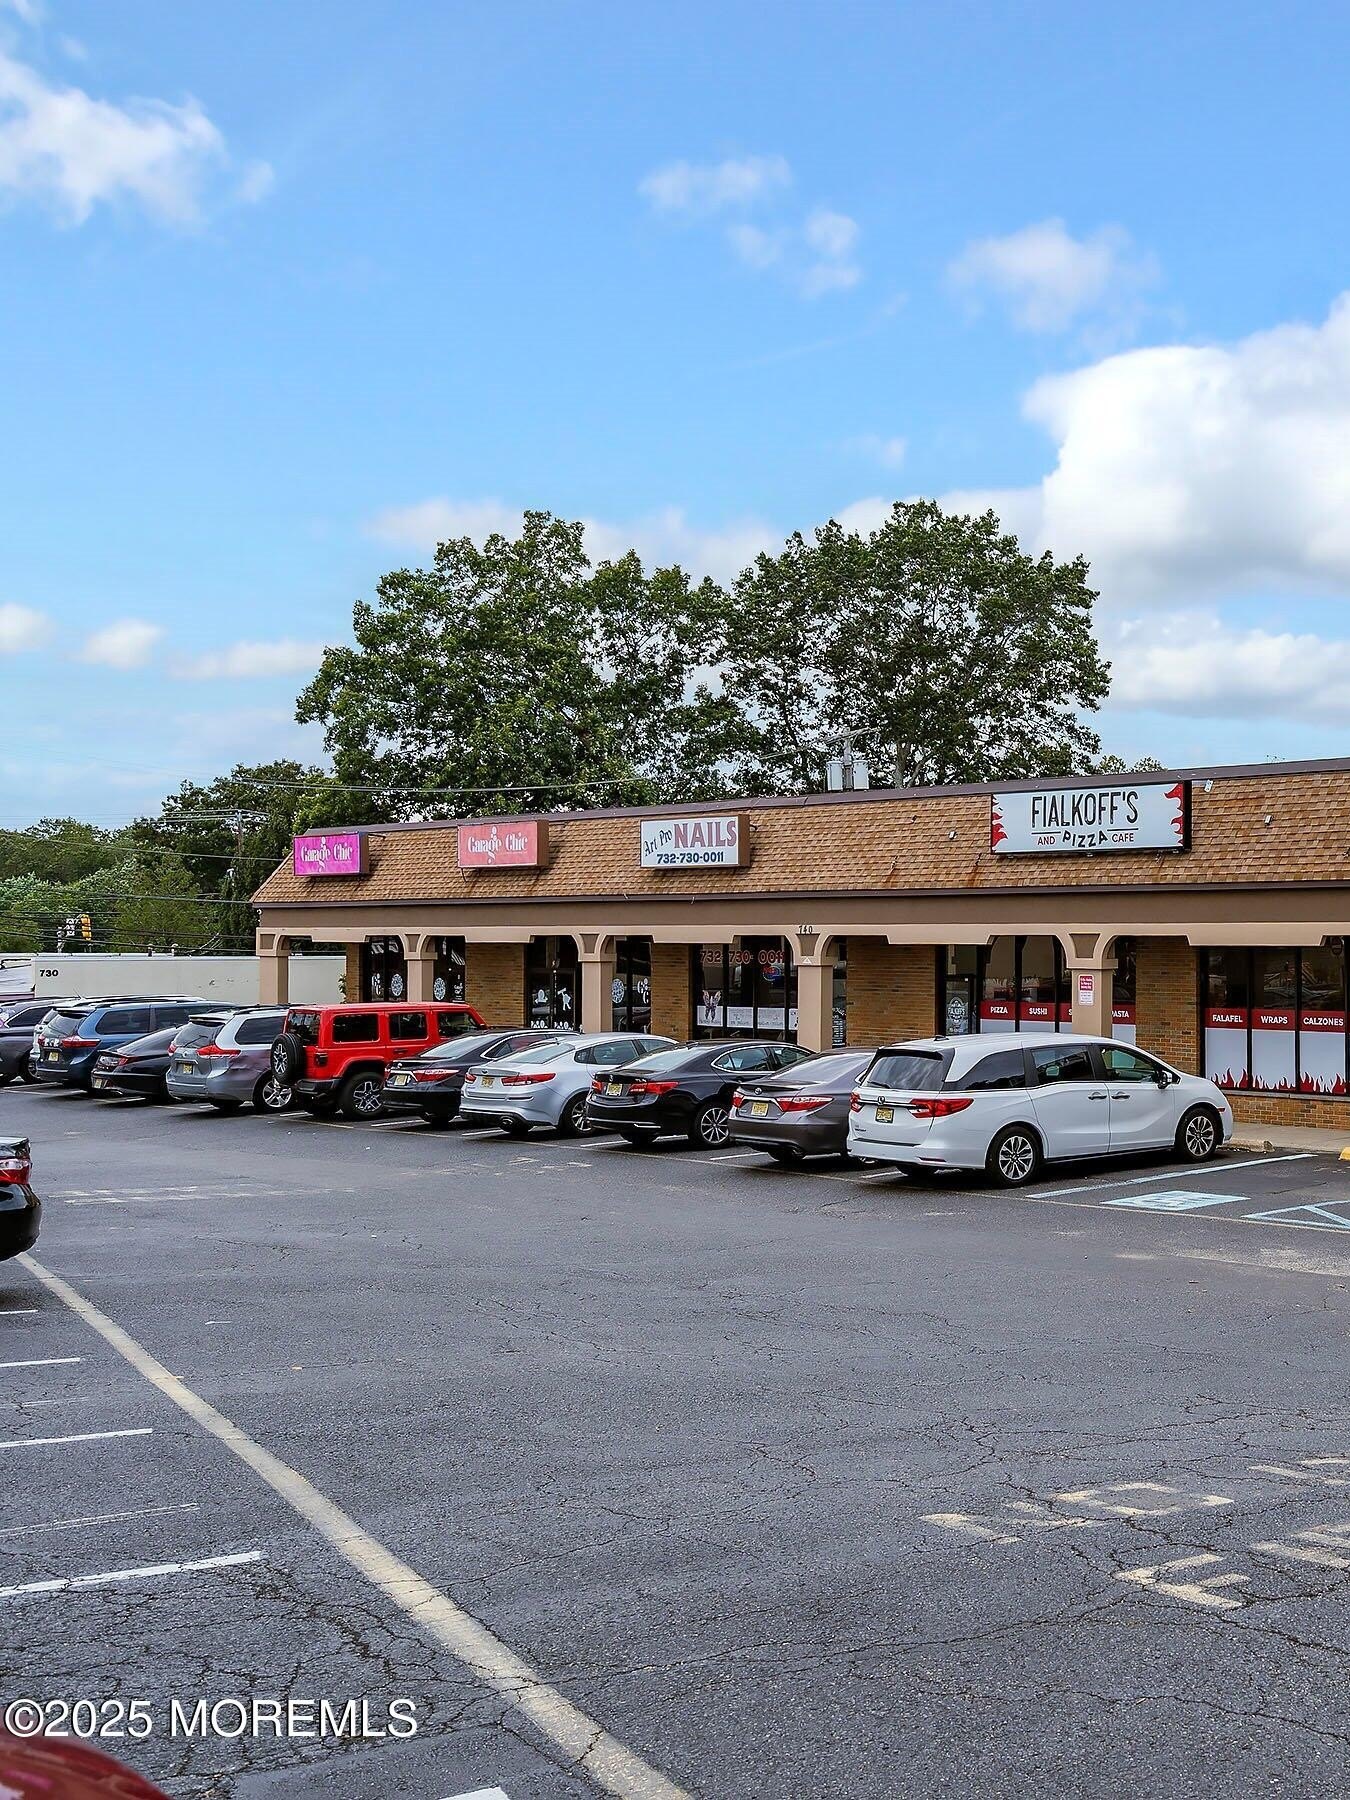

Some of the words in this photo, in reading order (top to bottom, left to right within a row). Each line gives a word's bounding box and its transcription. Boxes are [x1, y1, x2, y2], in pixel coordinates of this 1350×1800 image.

[1031, 790, 1139, 828] FIALKOFF'S
[644, 838, 658, 857] Art
[658, 829, 673, 847] Pro
[673, 820, 738, 849] NAILS
[1037, 836, 1056, 846] AND
[1061, 829, 1109, 848] PIZZA
[1111, 832, 1134, 843] CAFE
[467, 831, 502, 863] Garage
[504, 834, 529, 852] Chic
[300, 842, 332, 871] Garage
[333, 844, 353, 861] Chic
[656, 851, 724, 864] 732-730-0011
[39, 969, 60, 977] 730
[990, 1006, 1009, 1014] PIZZA
[1028, 1007, 1048, 1016] SUSHI
[1211, 1014, 1243, 1023] FALAFEL
[1260, 1015, 1288, 1024] WRAPS
[1303, 1016, 1344, 1026] CALZONES
